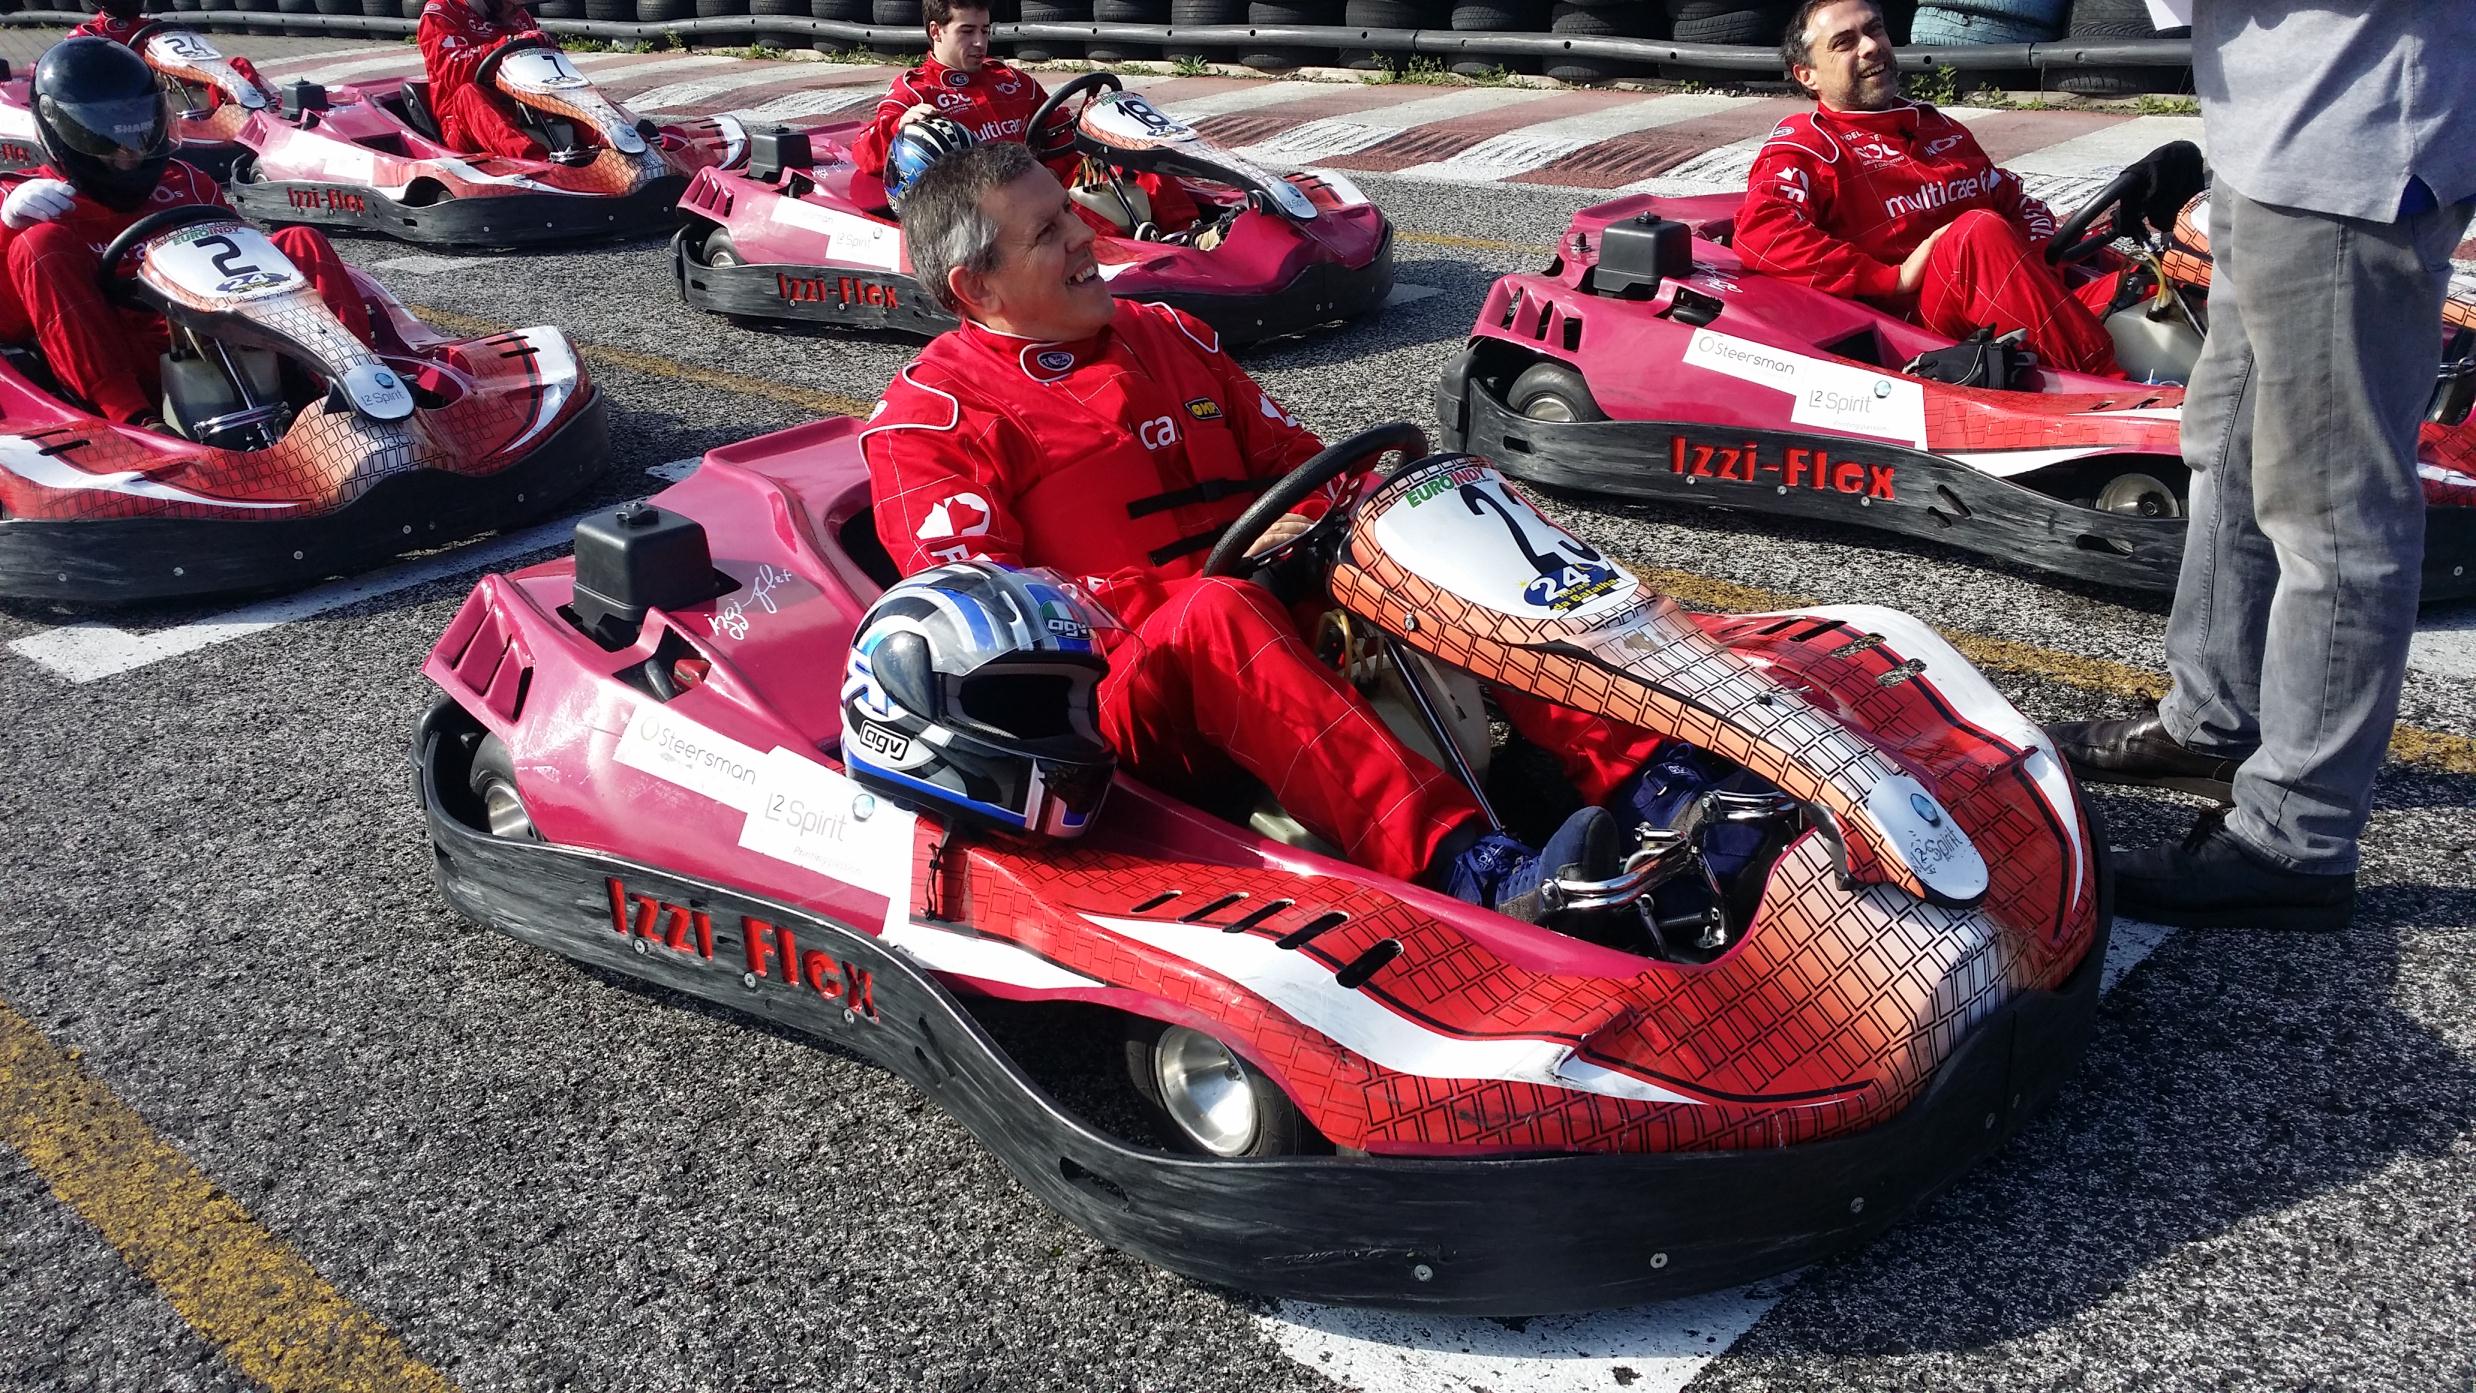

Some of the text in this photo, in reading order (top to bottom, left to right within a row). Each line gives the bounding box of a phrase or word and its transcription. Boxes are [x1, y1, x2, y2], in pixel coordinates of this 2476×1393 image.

[164, 36, 210, 55] 24
[541, 55, 566, 77] 7
[1114, 100, 1170, 129] 18
[173, 225, 239, 246] EUROINDY
[193, 235, 261, 278] 2
[228, 273, 270, 290] 24
[1714, 341, 1795, 376] Steersman
[372, 390, 405, 405] Spirit
[1825, 391, 1873, 415] Spirit
[1670, 434, 1896, 501] Izzi-Flex
[1404, 466, 1486, 509] EUROINDY
[1530, 565, 1592, 602] 24
[1570, 578, 1619, 602] Batalha
[864, 728, 902, 755] agv
[658, 727, 757, 786] Steersman
[786, 799, 848, 842] Spirit
